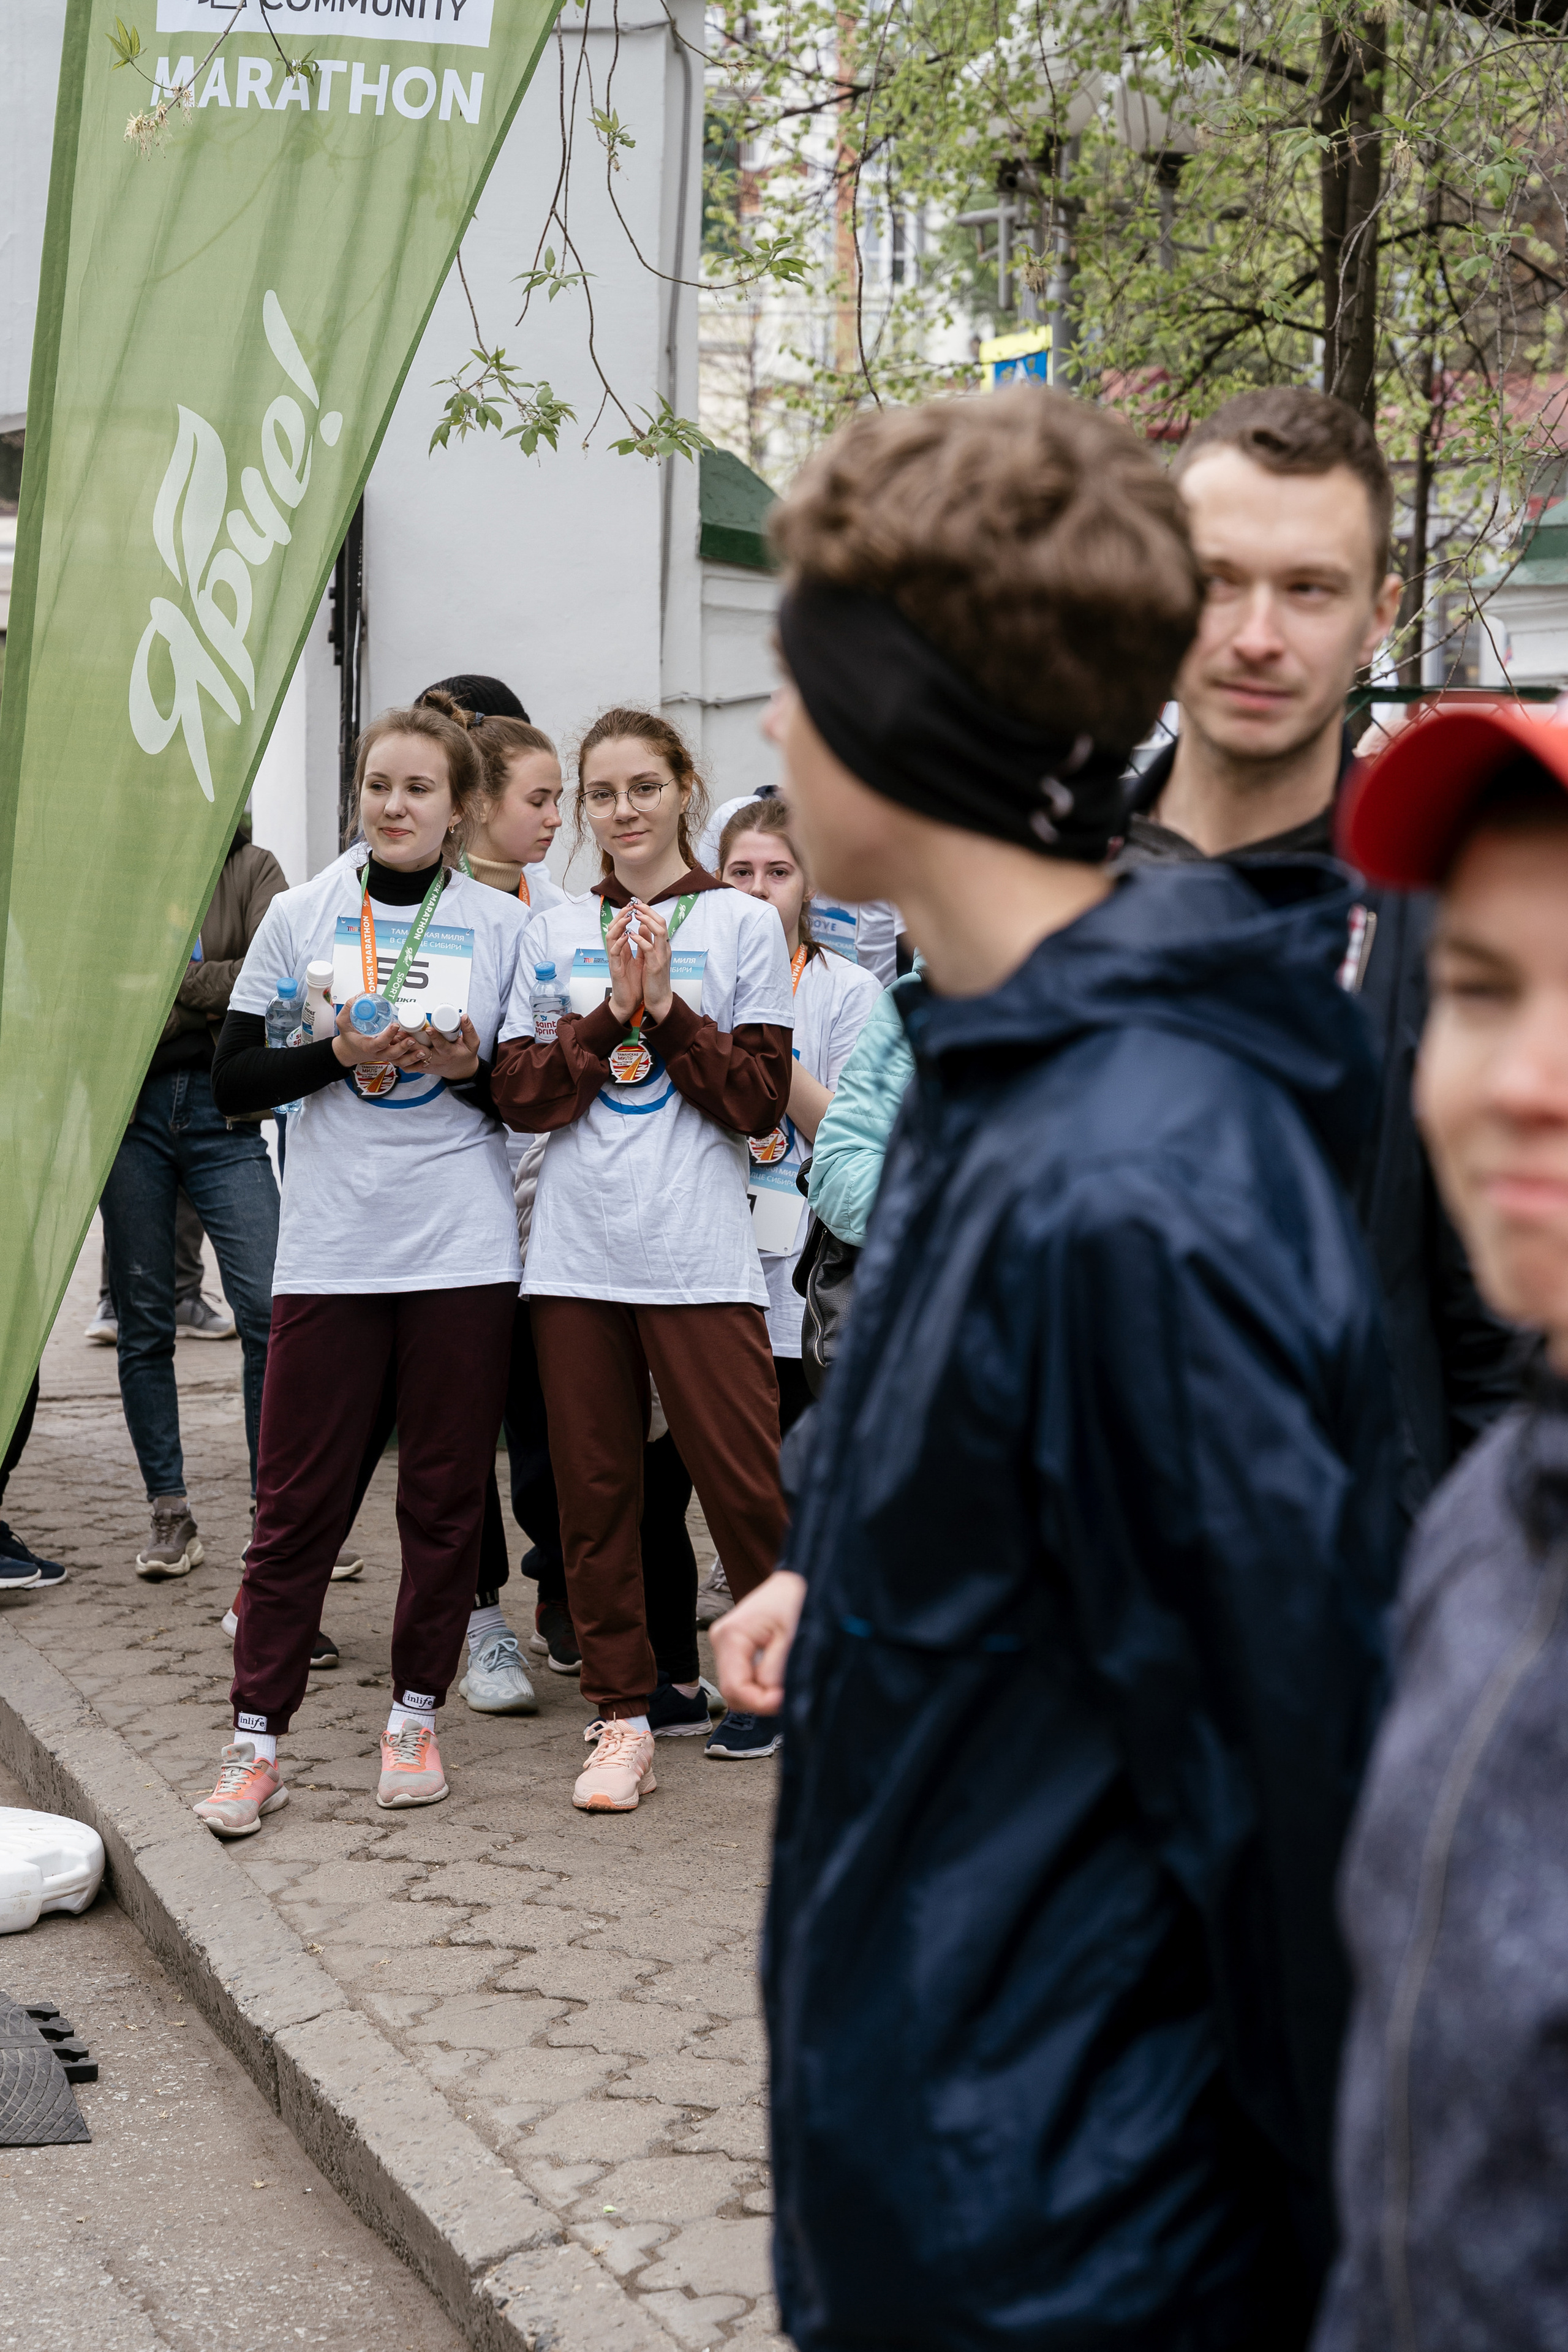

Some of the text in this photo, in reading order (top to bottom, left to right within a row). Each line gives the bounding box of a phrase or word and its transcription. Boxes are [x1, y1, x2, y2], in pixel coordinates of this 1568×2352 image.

[150, 55, 484, 124] MARATHON
[413, 873, 444, 940] MSK MARATHON
[391, 929, 440, 938] ТАМКАЯ
[814, 920, 837, 932] OVE
[363, 916, 373, 963] MARATHON
[397, 938, 428, 947] СЕЦЕ
[429, 941, 462, 950] СИБИРИ
[796, 943, 805, 965] OMSK
[366, 965, 375, 993] OMSK
[388, 972, 404, 1000] SPORT
[750, 1172, 796, 1188] ДЦЕ СИБИРИ
[779, 1168, 797, 1178] МИЛ
[407, 1694, 433, 1707] inlife
[239, 1716, 265, 1728] inlife
